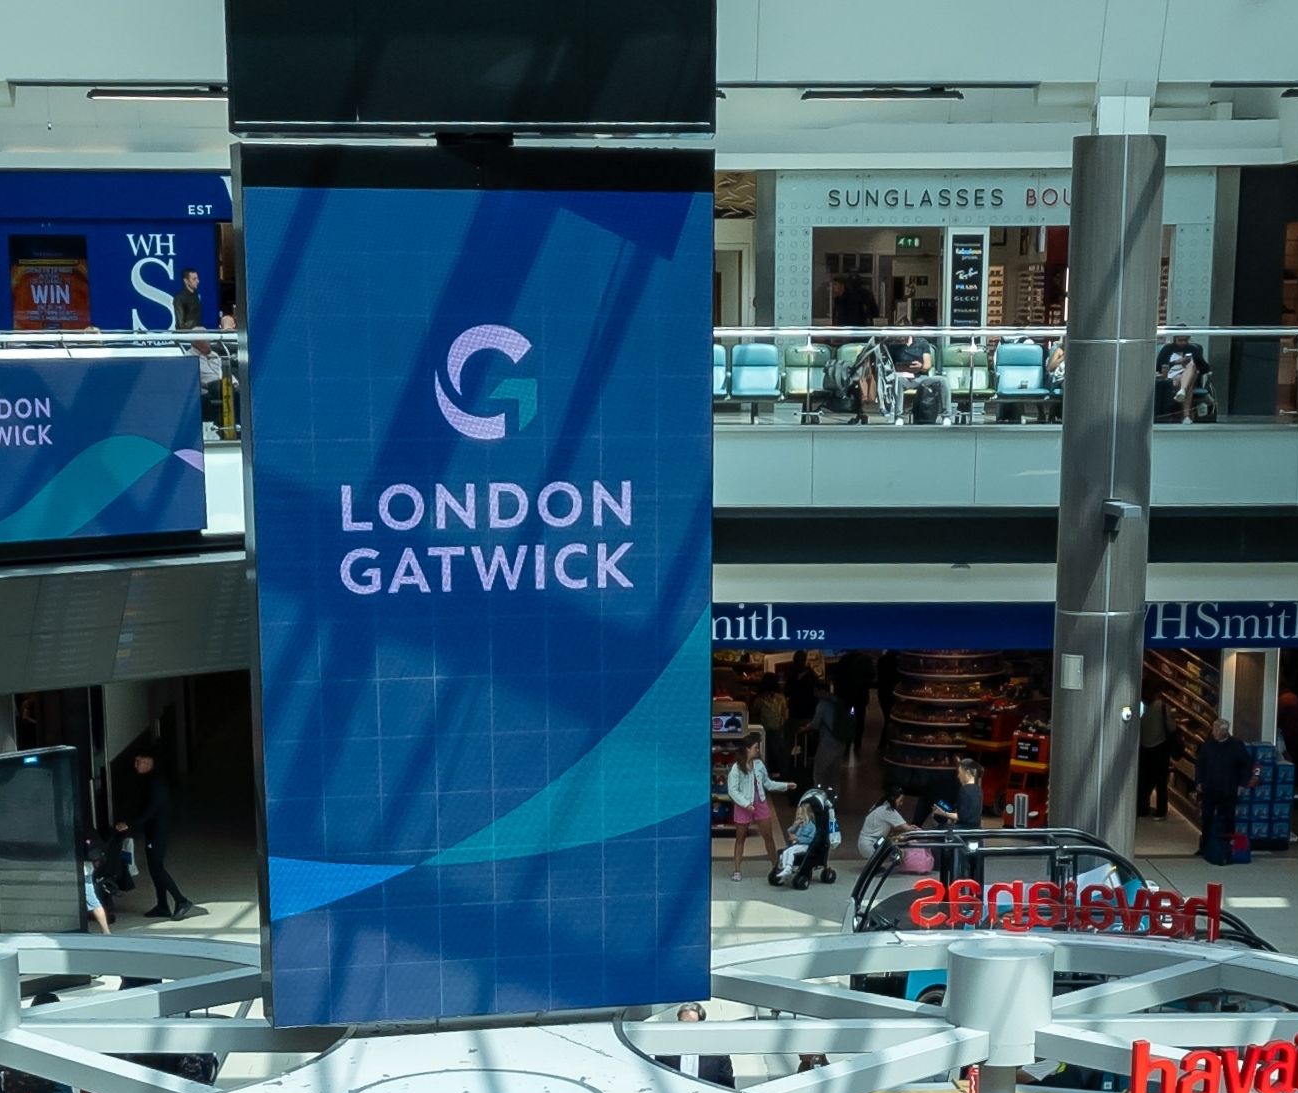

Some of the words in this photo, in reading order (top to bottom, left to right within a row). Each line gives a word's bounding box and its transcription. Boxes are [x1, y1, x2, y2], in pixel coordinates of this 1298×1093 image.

[828, 189, 1004, 207] SUNGLASSES
[188, 205, 212, 215] EST
[127, 234, 176, 256] WH
[31, 284, 70, 305] WIN
[131, 258, 175, 333] S
[340, 481, 632, 532] LONDON
[338, 542, 635, 595] GATWICK
[796, 630, 825, 640] 1792
